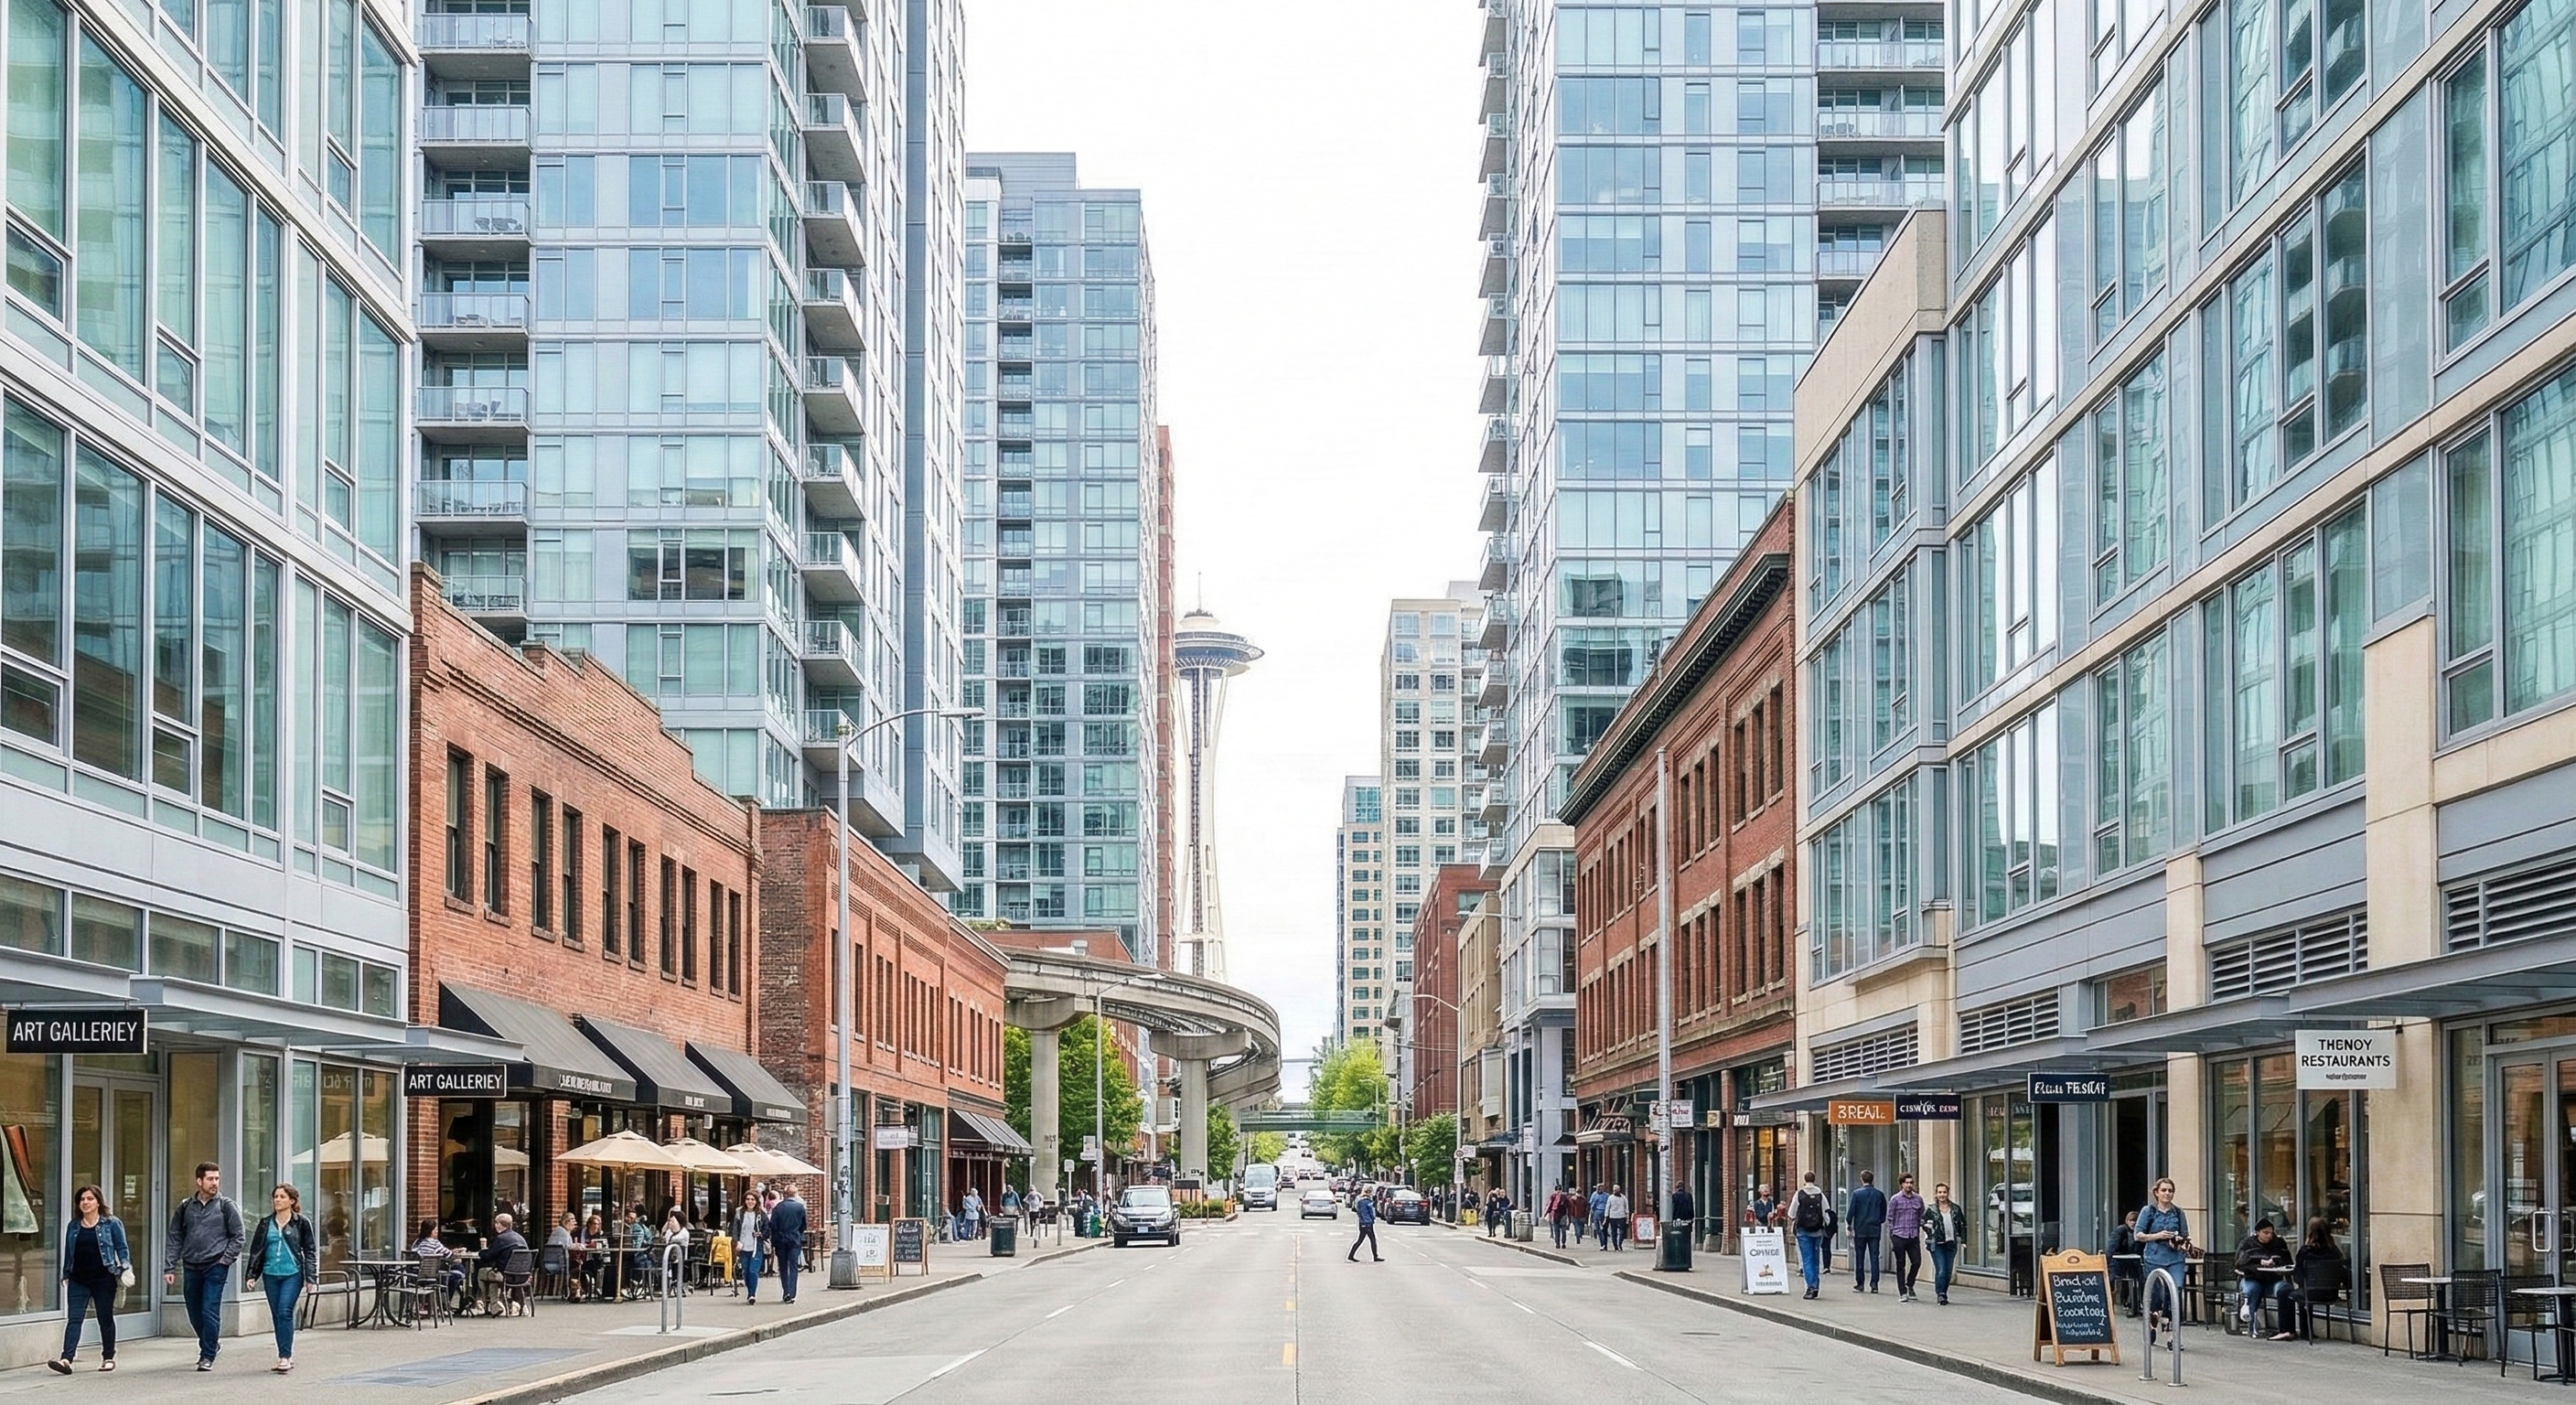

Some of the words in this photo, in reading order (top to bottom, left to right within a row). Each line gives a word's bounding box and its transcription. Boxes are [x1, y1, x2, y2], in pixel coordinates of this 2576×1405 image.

[13, 1022, 46, 1042] ART
[49, 1021, 138, 1042] GALLERIEY
[2317, 1038, 2373, 1051] THENOY
[2301, 1055, 2391, 1067] RESTAURANTS
[409, 1074, 434, 1089] ART
[436, 1074, 503, 1089] GALLERIEY
